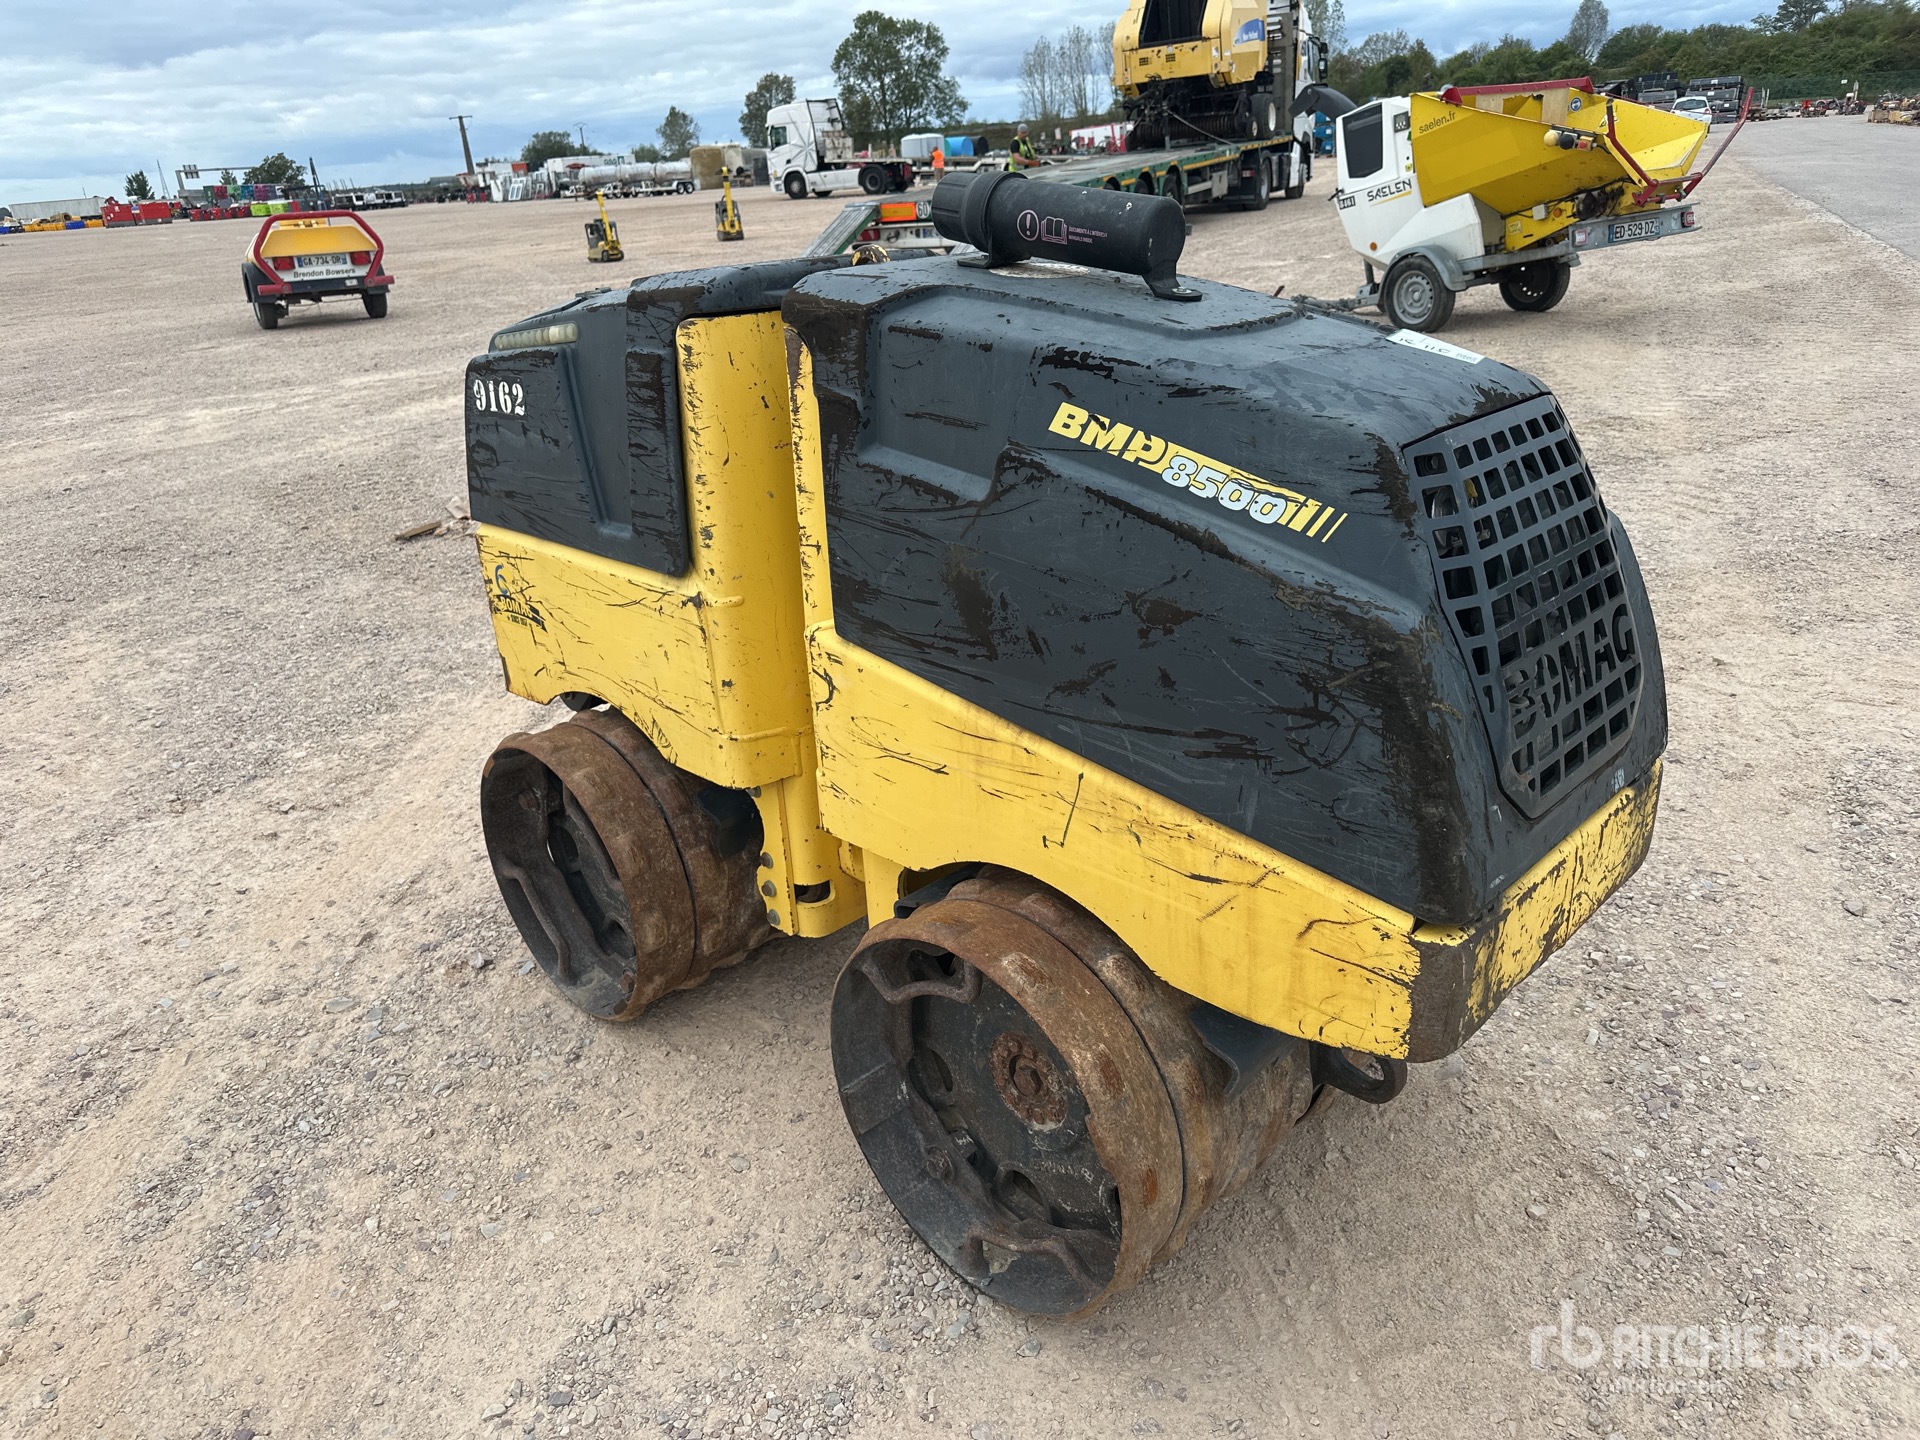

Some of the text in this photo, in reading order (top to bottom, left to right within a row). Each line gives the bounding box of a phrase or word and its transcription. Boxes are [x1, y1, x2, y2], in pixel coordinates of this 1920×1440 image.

[1419, 110, 1456, 134] saelen.fr
[1366, 178, 1413, 202] SAELEN
[917, 203, 929, 217] 60
[293, 268, 356, 278] Brendon Bowsers
[473, 380, 525, 416] 9162
[1502, 602, 1637, 741] BOMAG
